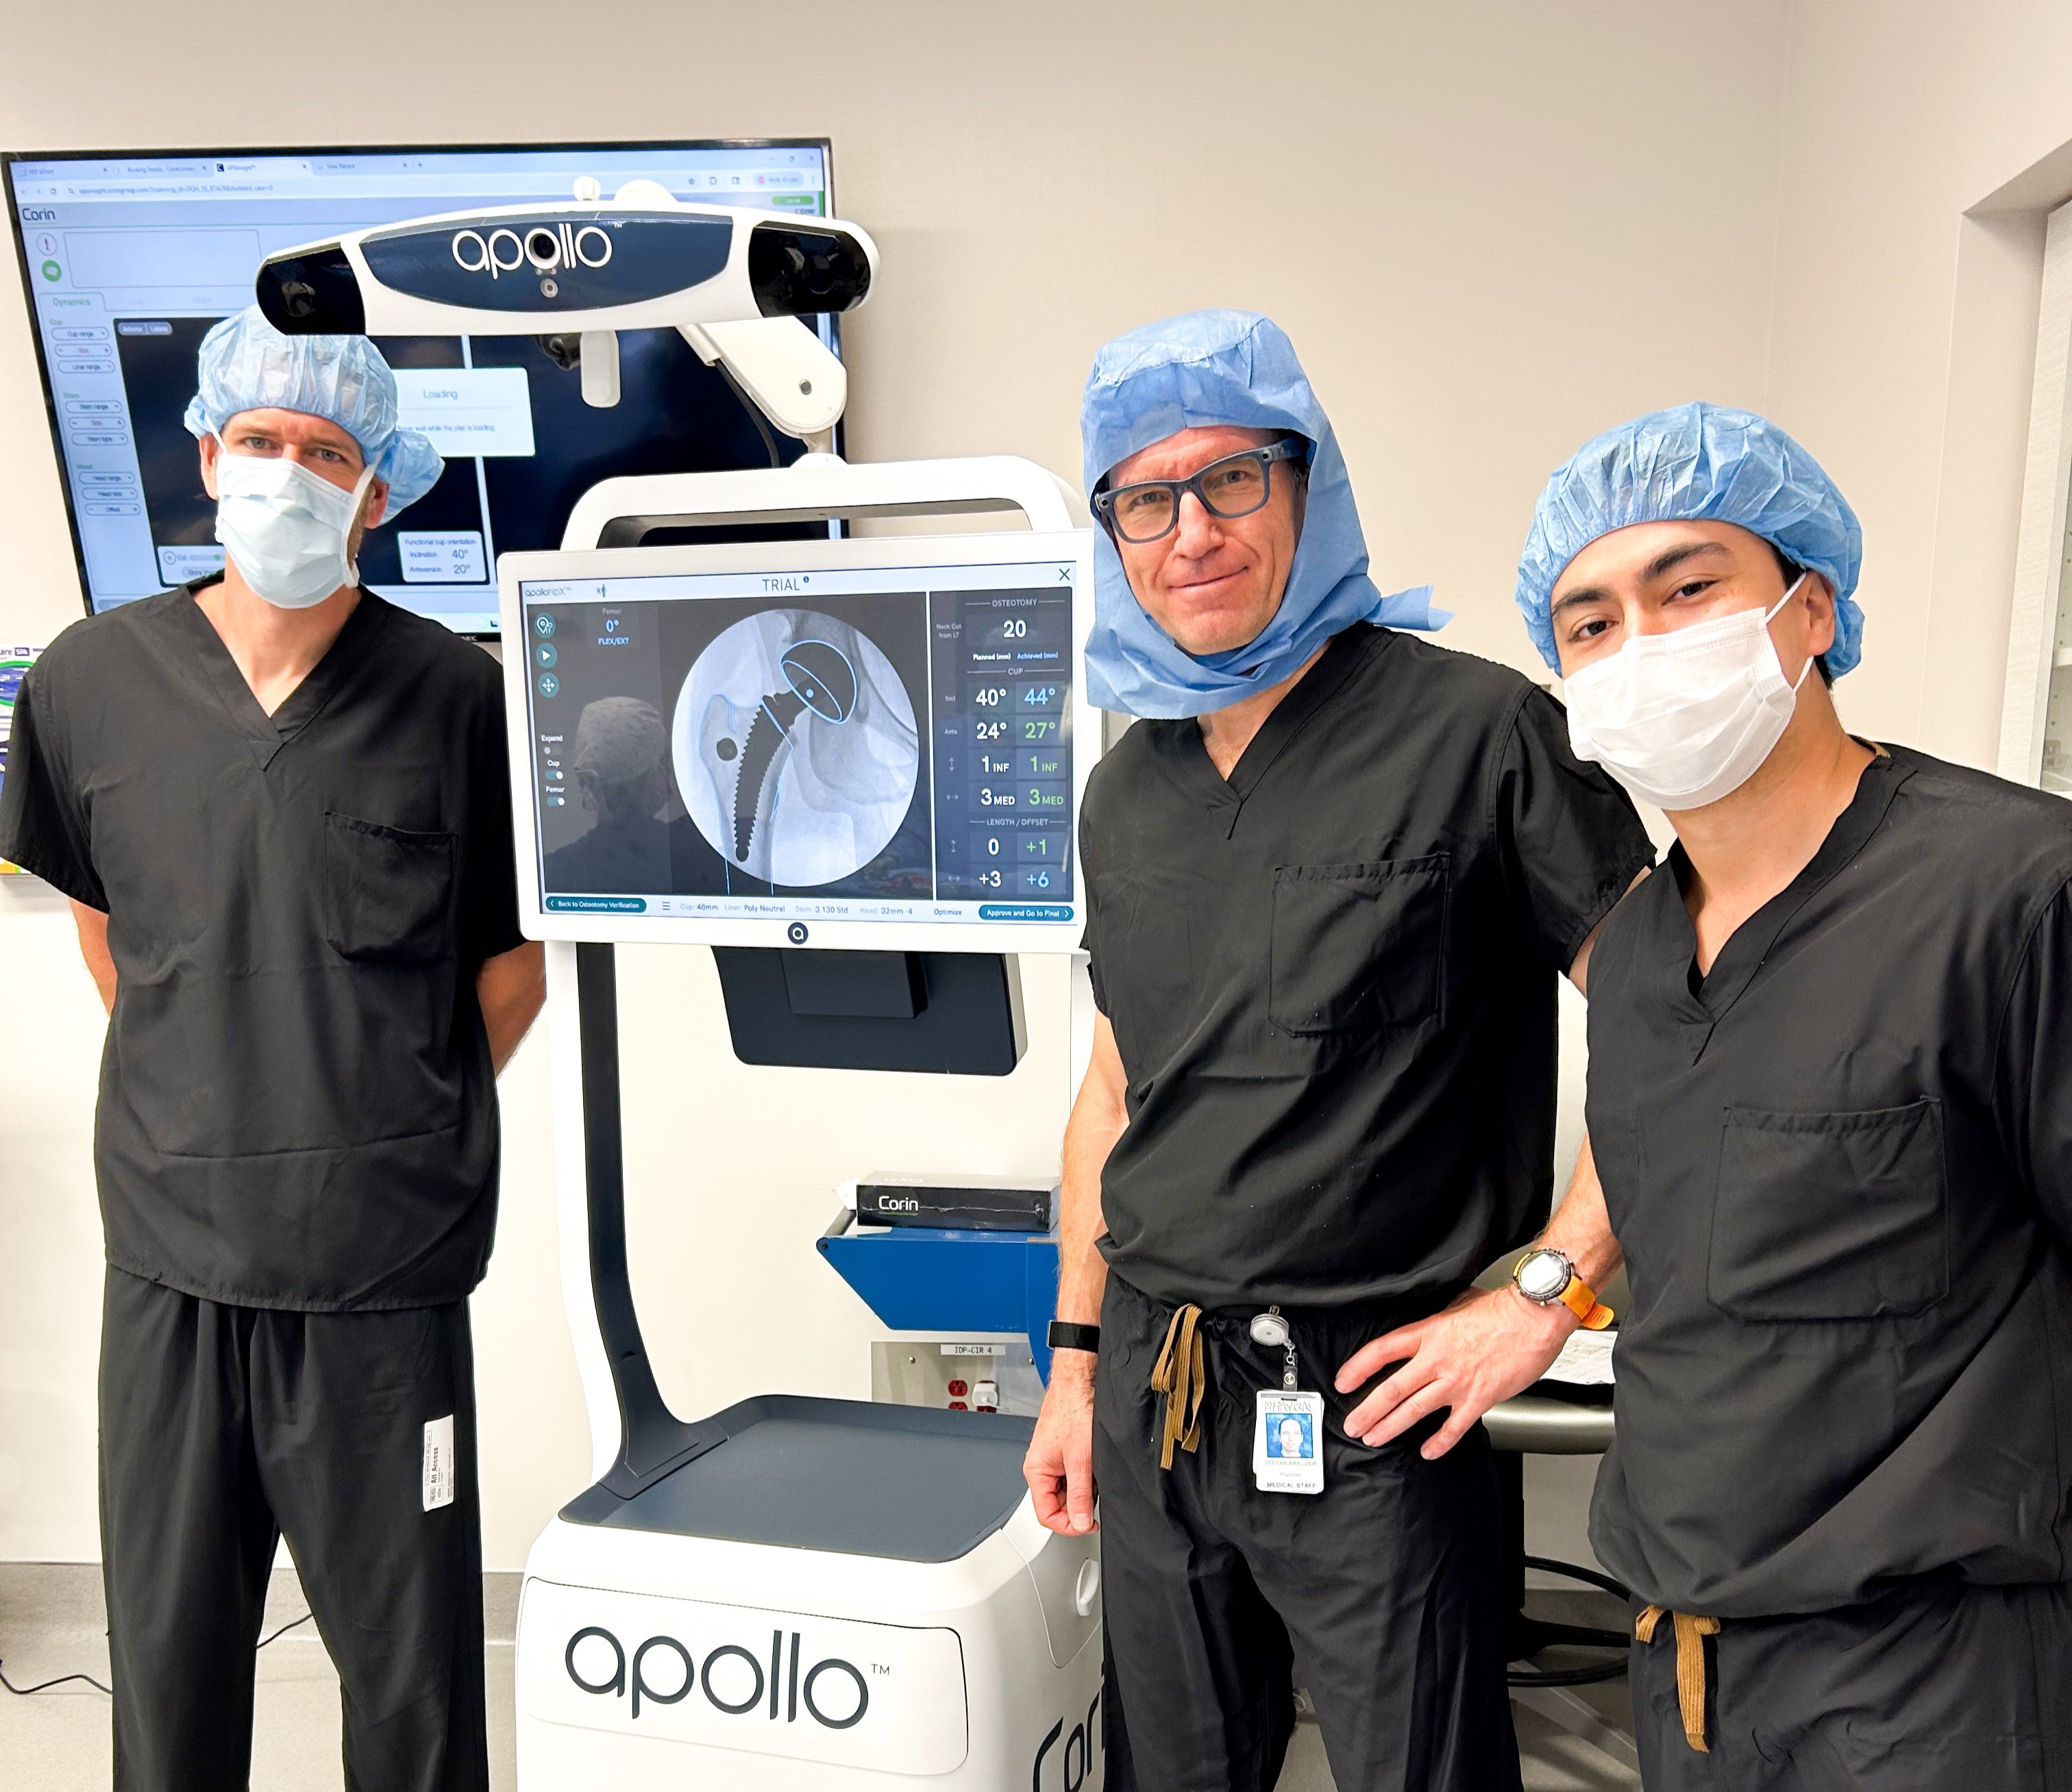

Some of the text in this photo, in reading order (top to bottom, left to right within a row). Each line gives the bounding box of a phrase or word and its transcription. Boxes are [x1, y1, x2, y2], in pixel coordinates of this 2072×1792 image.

[22, 208, 56, 221] Corin
[452, 223, 613, 280] apollo
[53, 297, 91, 308] Dynamics
[423, 389, 458, 400] Loading
[452, 550, 469, 559] 40°
[454, 565, 471, 574] 20°
[762, 578, 800, 591] TRIAL
[992, 599, 1037, 608] OSTEOTOMY
[606, 619, 619, 633] 0°
[1003, 619, 1027, 638] 20
[597, 637, 630, 646] FLEX/EXT
[996, 653, 1011, 661] (mm)
[976, 688, 1007, 707] 40°
[1024, 687, 1056, 705] 44°
[976, 722, 1007, 739] 24°
[1025, 722, 1056, 739] 27°
[541, 735, 563, 743] Expand
[994, 763, 1010, 773] INF
[1041, 763, 1059, 772] INF
[988, 837, 1046, 855] 0 +1
[979, 870, 1050, 888] +3 +6
[579, 901, 608, 909] Osteotomy
[744, 905, 758, 913] Poly
[987, 909, 1011, 917] Approve
[878, 1195, 919, 1211] Corin
[954, 1346, 984, 1354] IDP-CIR
[565, 1626, 869, 1729] apollo
